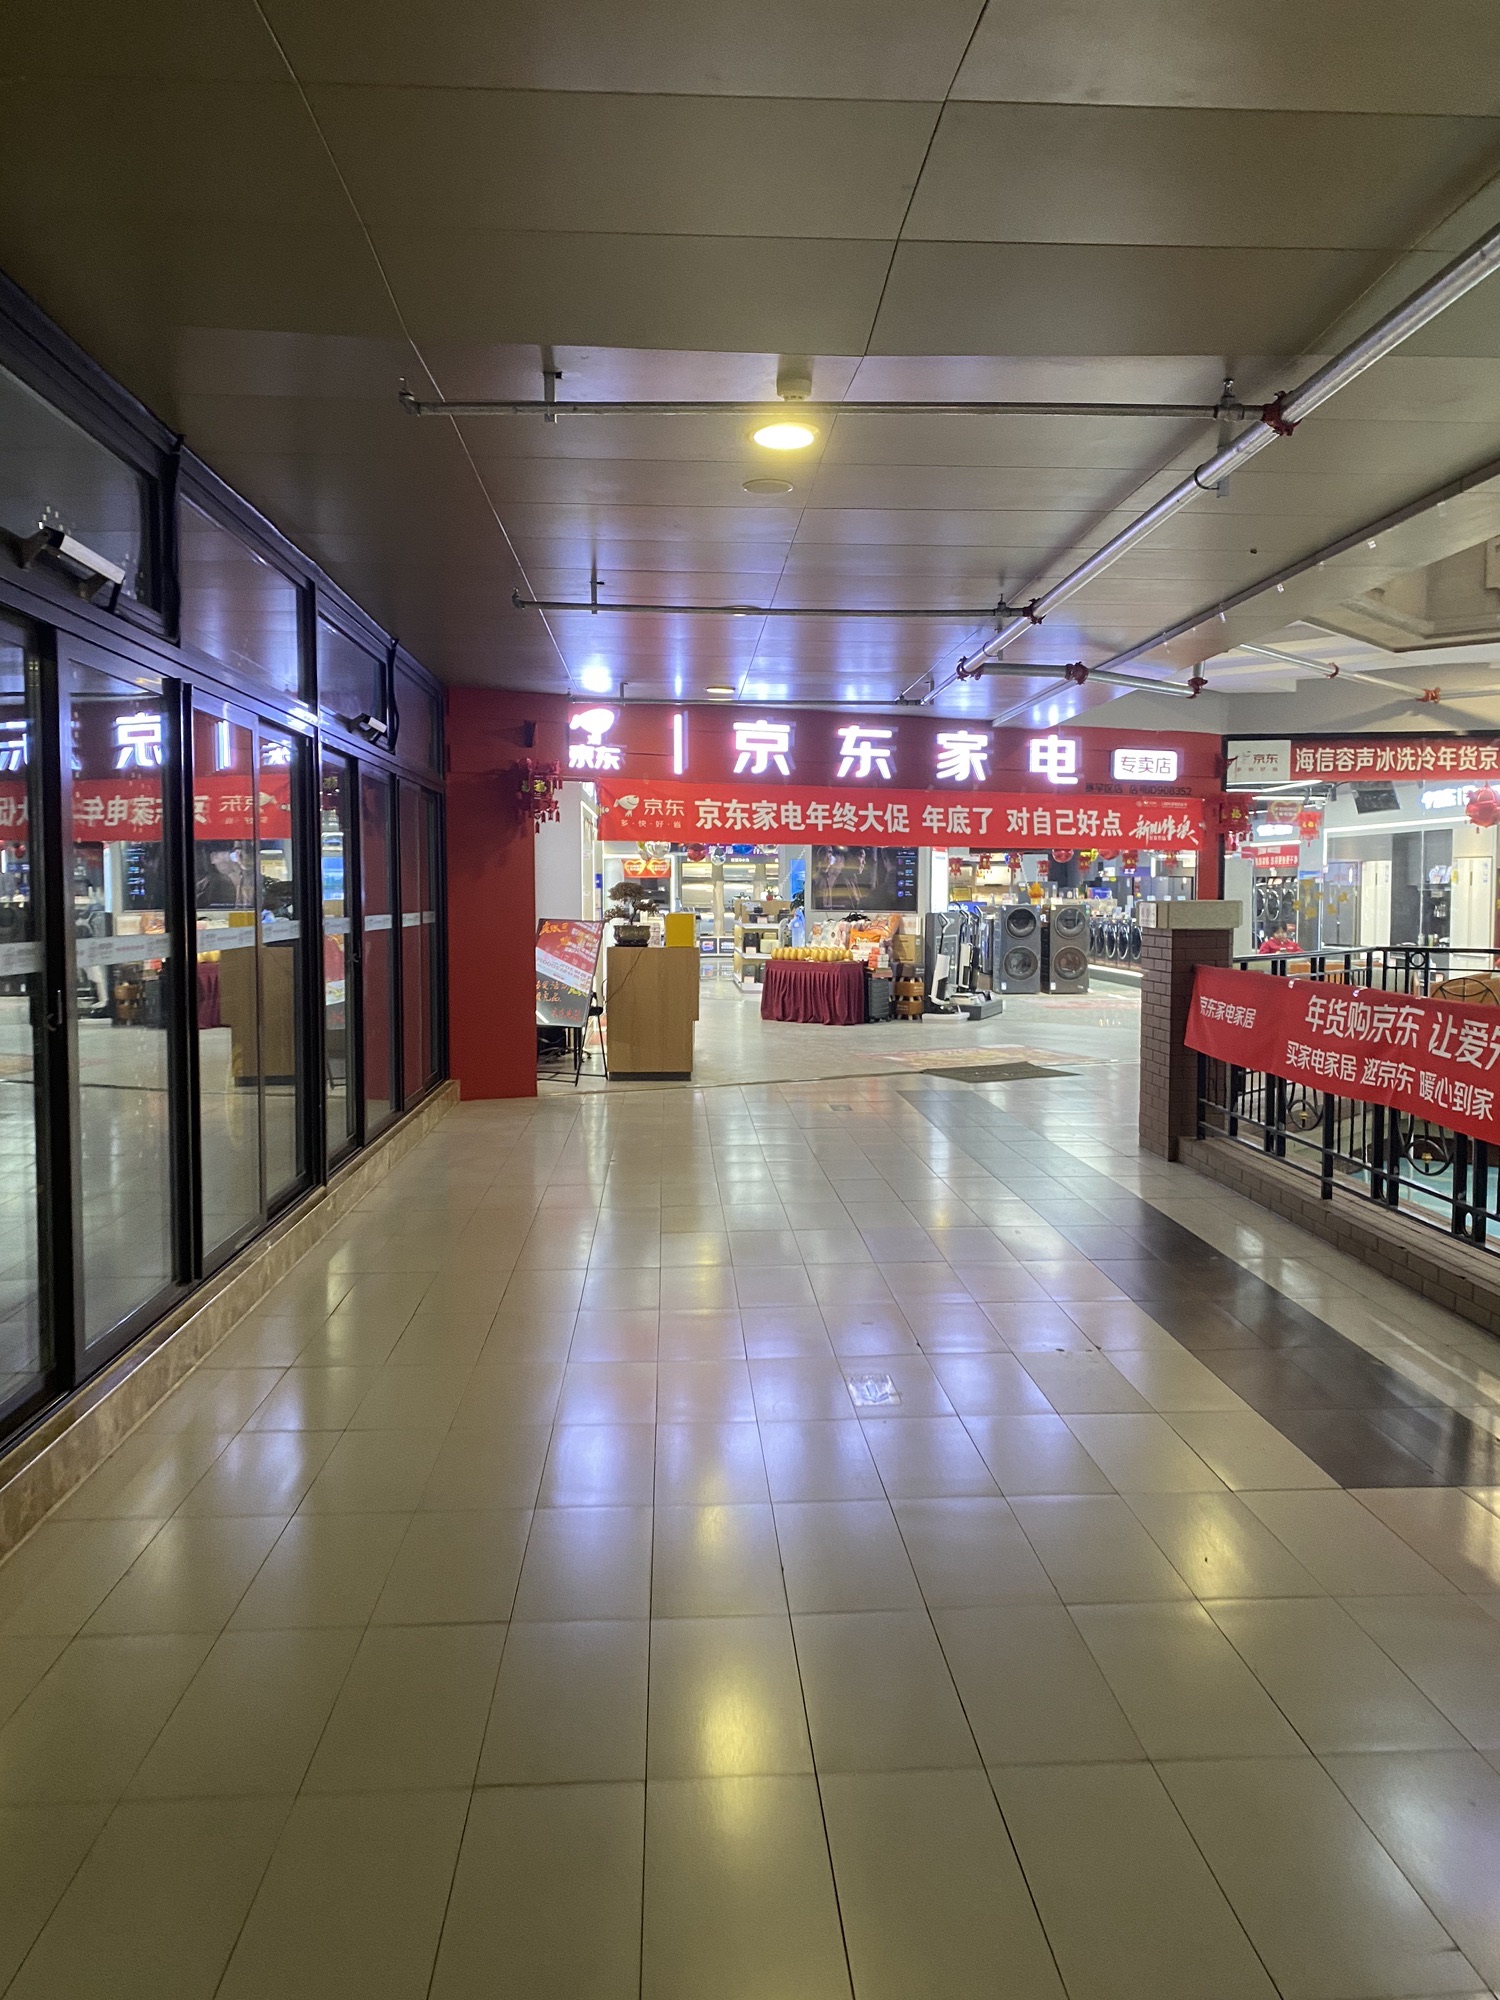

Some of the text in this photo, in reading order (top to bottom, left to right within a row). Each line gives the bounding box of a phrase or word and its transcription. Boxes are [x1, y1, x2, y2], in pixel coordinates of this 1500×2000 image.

[568, 744, 622, 771] 京东
[731, 718, 1080, 786] 京东家电
[1120, 756, 1171, 775] 专卖店
[1252, 753, 1279, 764] 京东
[1295, 746, 1500, 773] 海信容声冰洗冷年货京
[643, 797, 686, 817] 京东
[694, 797, 1123, 838] 京东家电年终大促 年底了 对自己好点
[1198, 995, 1257, 1030] 京东家电家居
[1304, 993, 1426, 1048] 年货购京东
[1285, 1040, 1495, 1122] 买家电家居 逛京东 暖心到家
